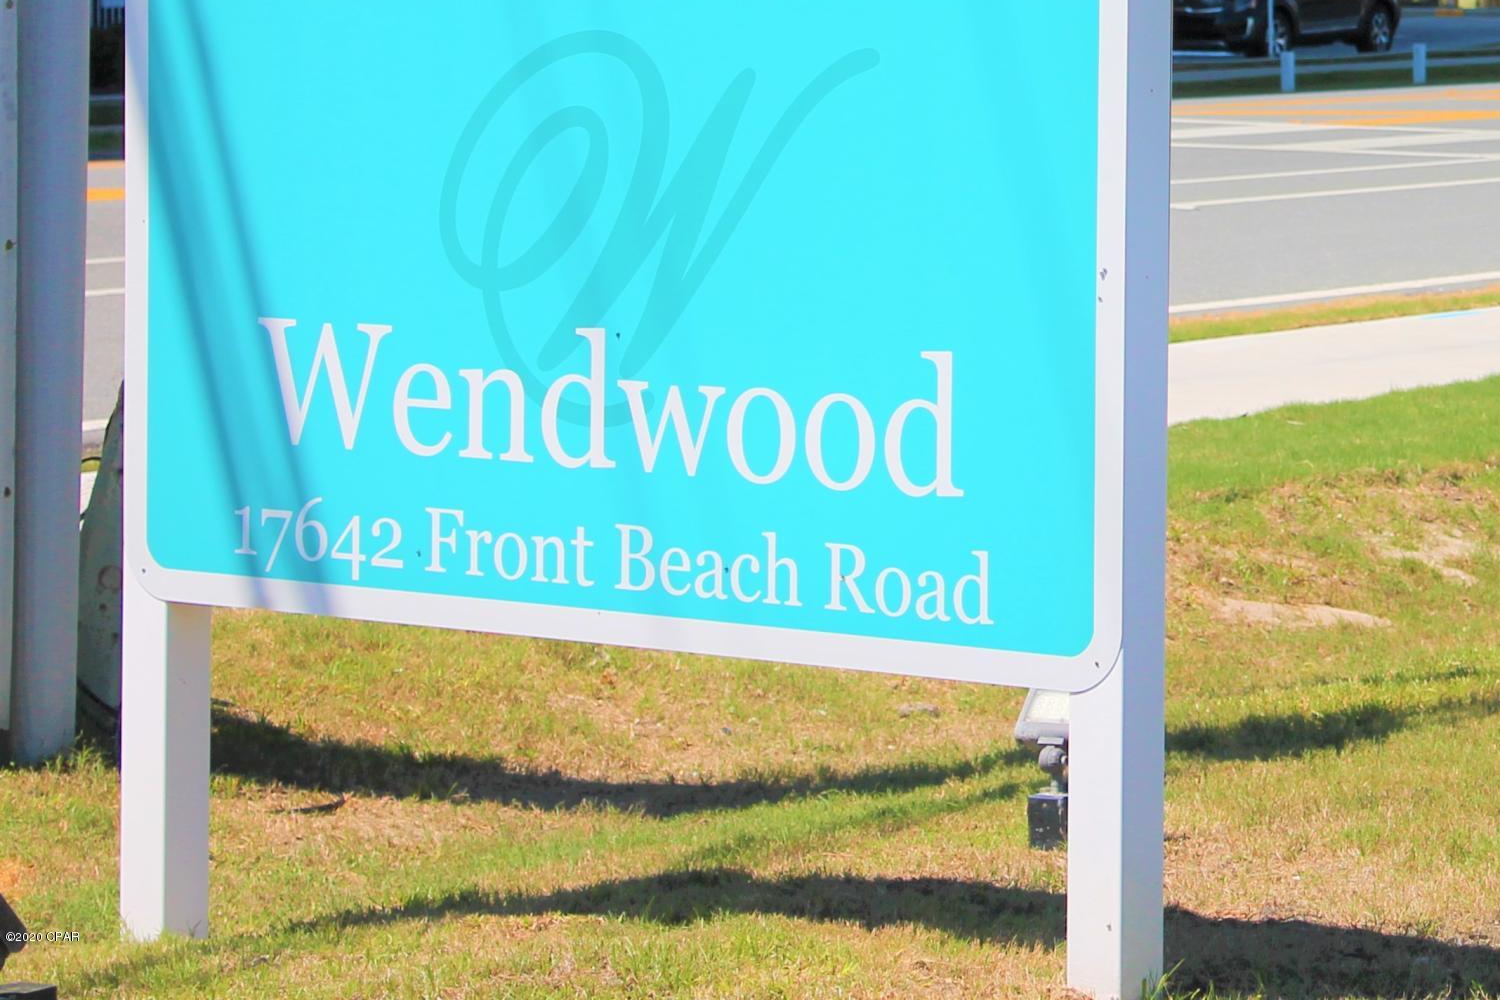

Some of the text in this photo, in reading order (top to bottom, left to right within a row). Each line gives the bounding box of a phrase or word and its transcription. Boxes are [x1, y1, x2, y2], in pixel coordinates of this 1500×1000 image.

[439, 29, 881, 428] W
[258, 317, 965, 498] Wendwood
[233, 496, 994, 625] 17642 Front Beach Road
